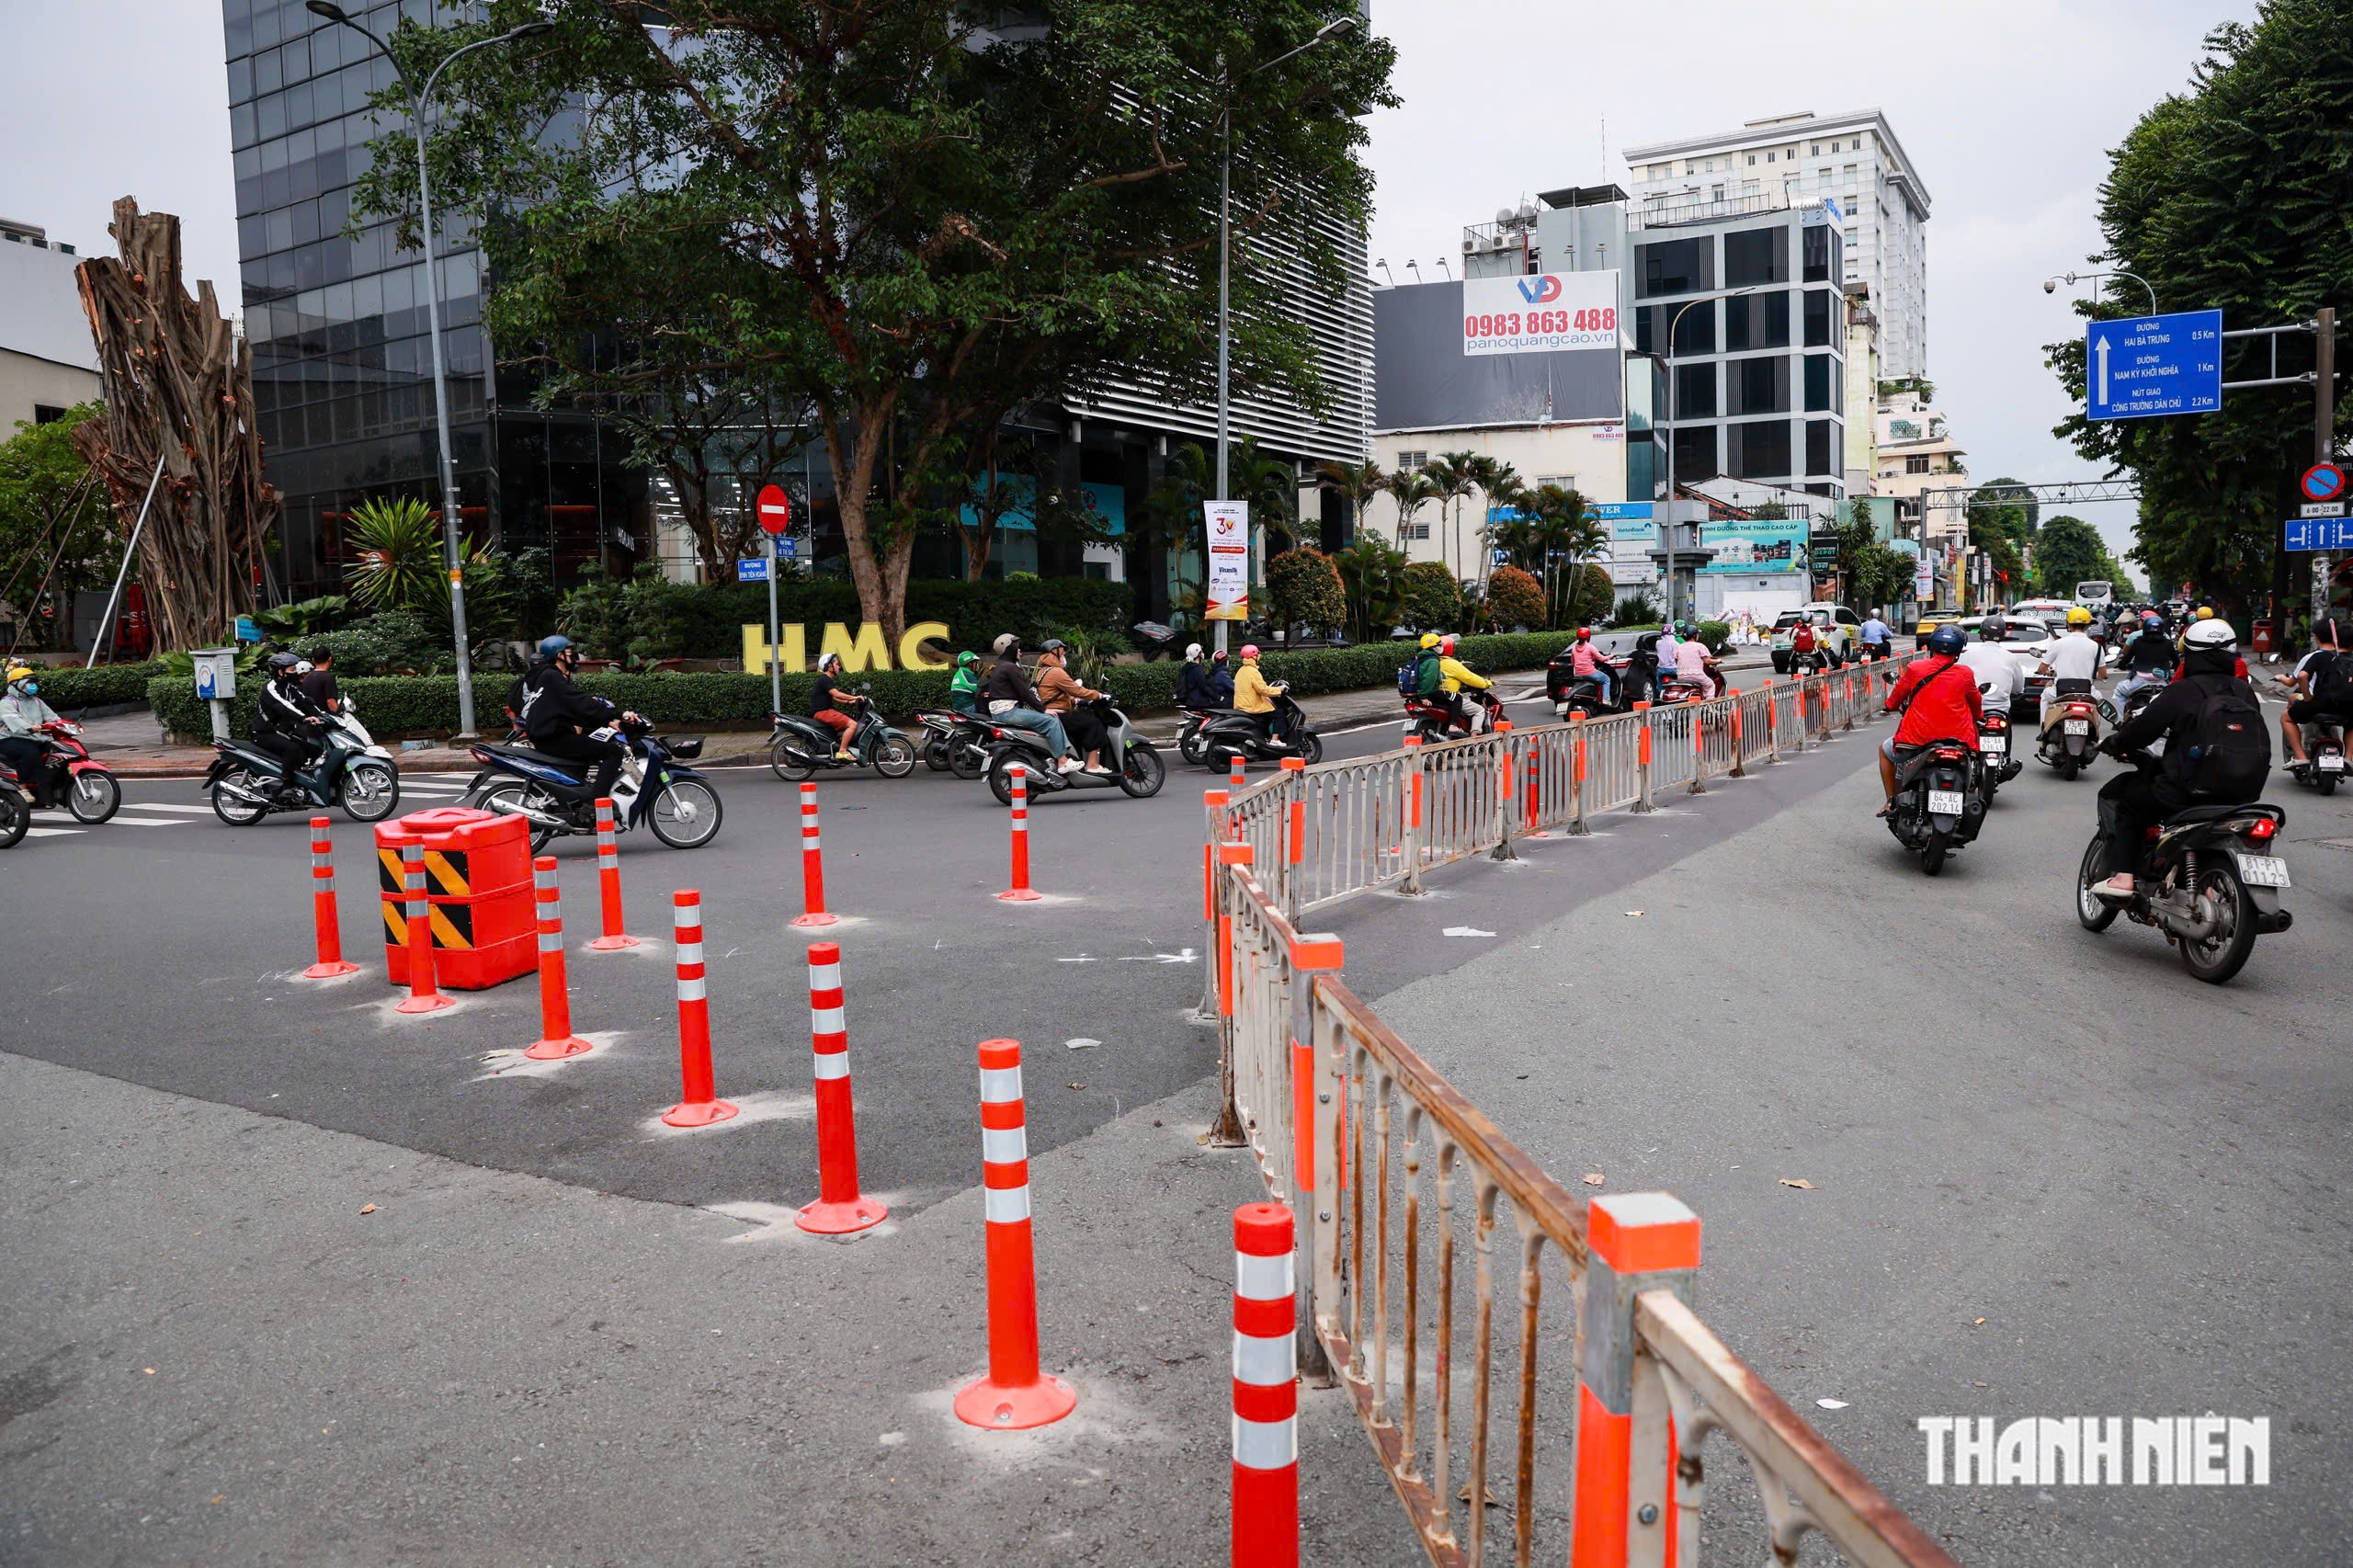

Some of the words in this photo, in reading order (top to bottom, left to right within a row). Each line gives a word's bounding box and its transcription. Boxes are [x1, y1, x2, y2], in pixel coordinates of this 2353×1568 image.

[1465, 312, 1521, 338] 0983
[1527, 311, 1568, 335] 863
[1574, 308, 1616, 332] 488
[2136, 322, 2160, 332] ĐƯỜNG
[2192, 331, 2201, 340] 0.5
[2203, 330, 2214, 339] Km
[1467, 332, 1614, 352] panoquangcao.vn
[2124, 337, 2136, 347] HAI
[2137, 335, 2146, 346] BÀ
[2148, 335, 2170, 346] TRƯNG
[2136, 354, 2160, 365] ĐƯỜNG
[2114, 370, 2130, 381] NAM
[2142, 366, 2157, 378] KHỞI
[2158, 364, 2179, 376] NGHĨA
[2202, 363, 2214, 372] Km
[2132, 387, 2144, 397] NÚT
[2146, 387, 2161, 396] GIAO
[2111, 402, 2129, 412] CÔNG
[2129, 399, 2153, 411] TRƯỜNG
[2169, 395, 2182, 408] CHỦ
[2192, 397, 2201, 406] 2.2
[2202, 396, 2214, 405] Km
[741, 621, 950, 676] HMC
[1934, 792, 1958, 803] 64-AC
[1931, 801, 1960, 813] 202.14
